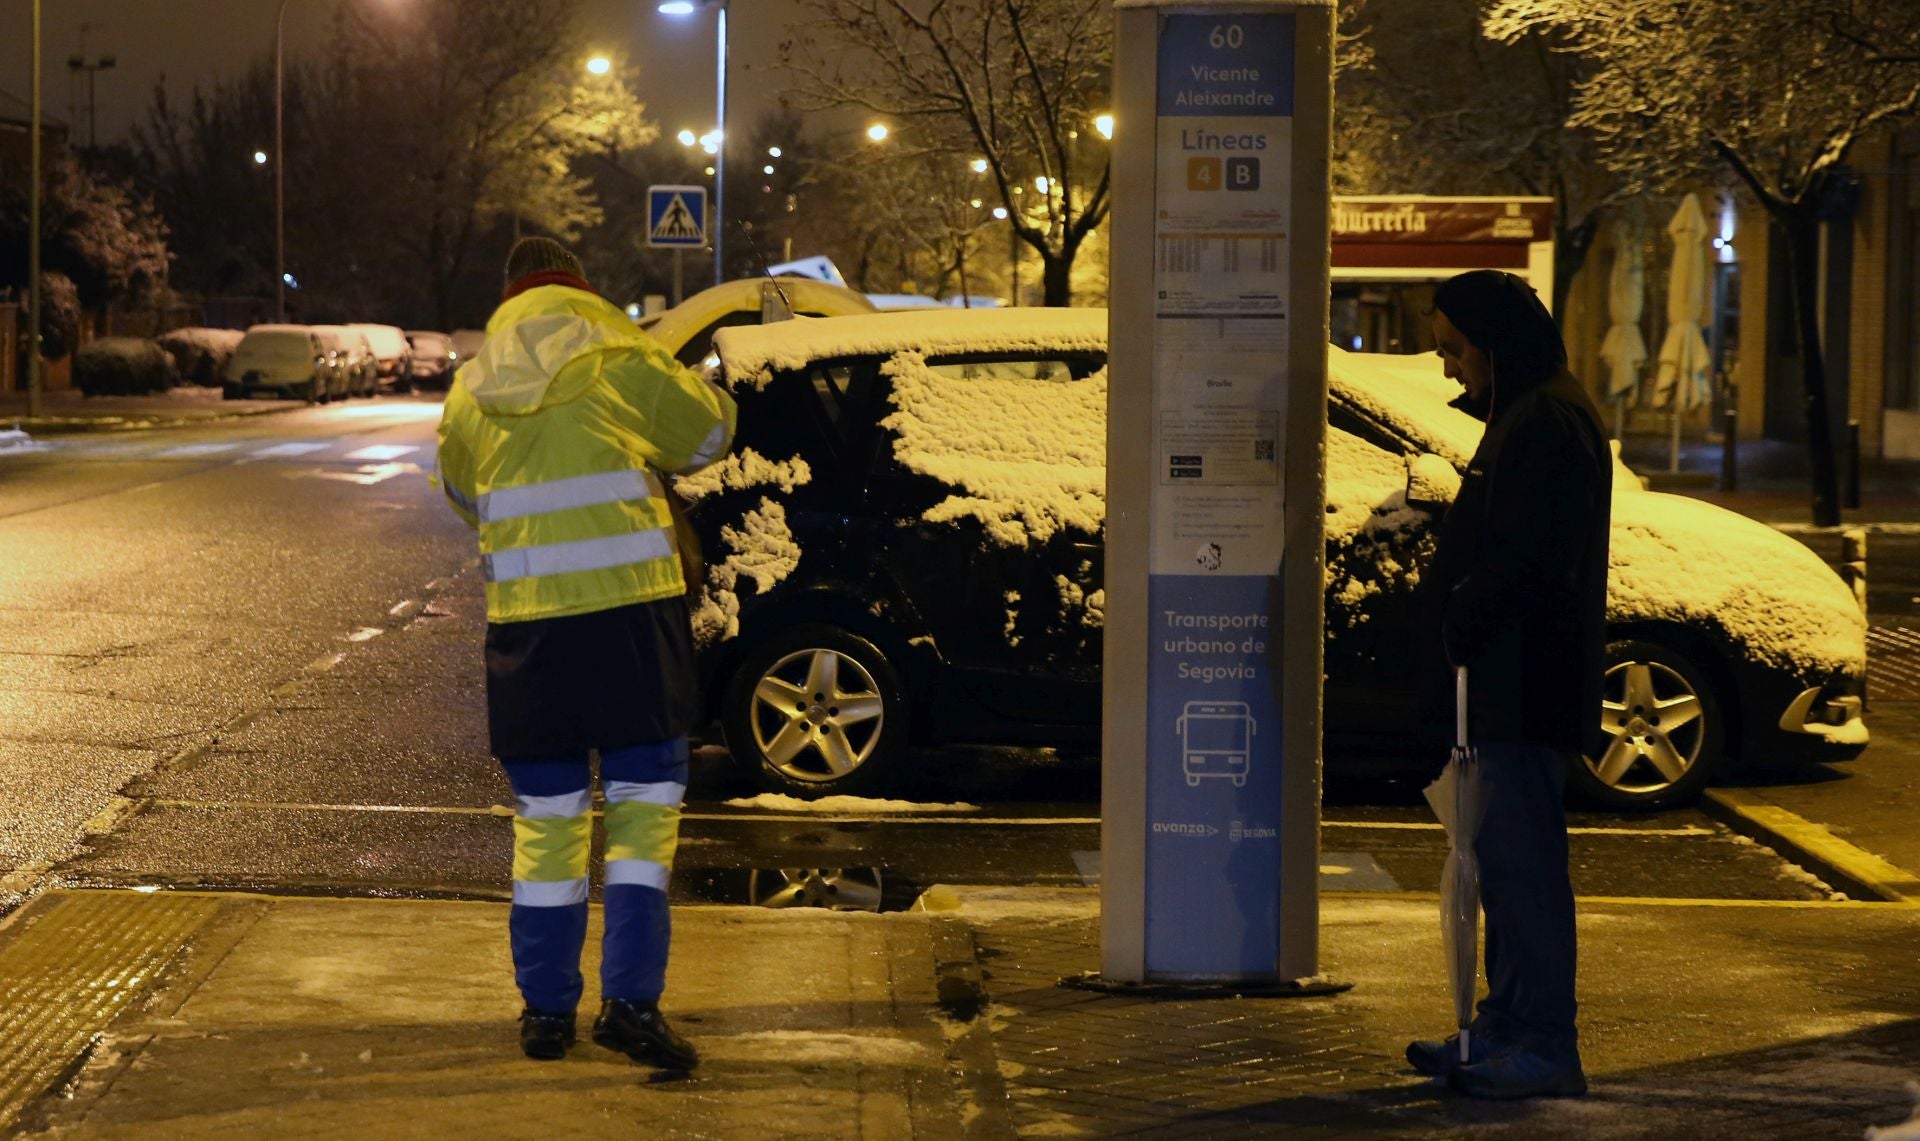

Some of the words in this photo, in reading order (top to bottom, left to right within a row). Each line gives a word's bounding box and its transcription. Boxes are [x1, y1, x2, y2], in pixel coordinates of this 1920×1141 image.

[1209, 24, 1244, 49] 60
[1191, 65, 1260, 82] Vicente
[1175, 89, 1275, 106] Aleixandre
[1181, 129, 1267, 151] Líneas
[1196, 166, 1212, 184] 4
[1235, 164, 1251, 185] B
[1331, 203, 1426, 234] hurrería
[1164, 610, 1269, 632] Transporte
[1164, 637, 1236, 654] urbano
[1241, 637, 1266, 654] de
[1177, 662, 1257, 683] Segovia
[1152, 822, 1206, 834] avanza
